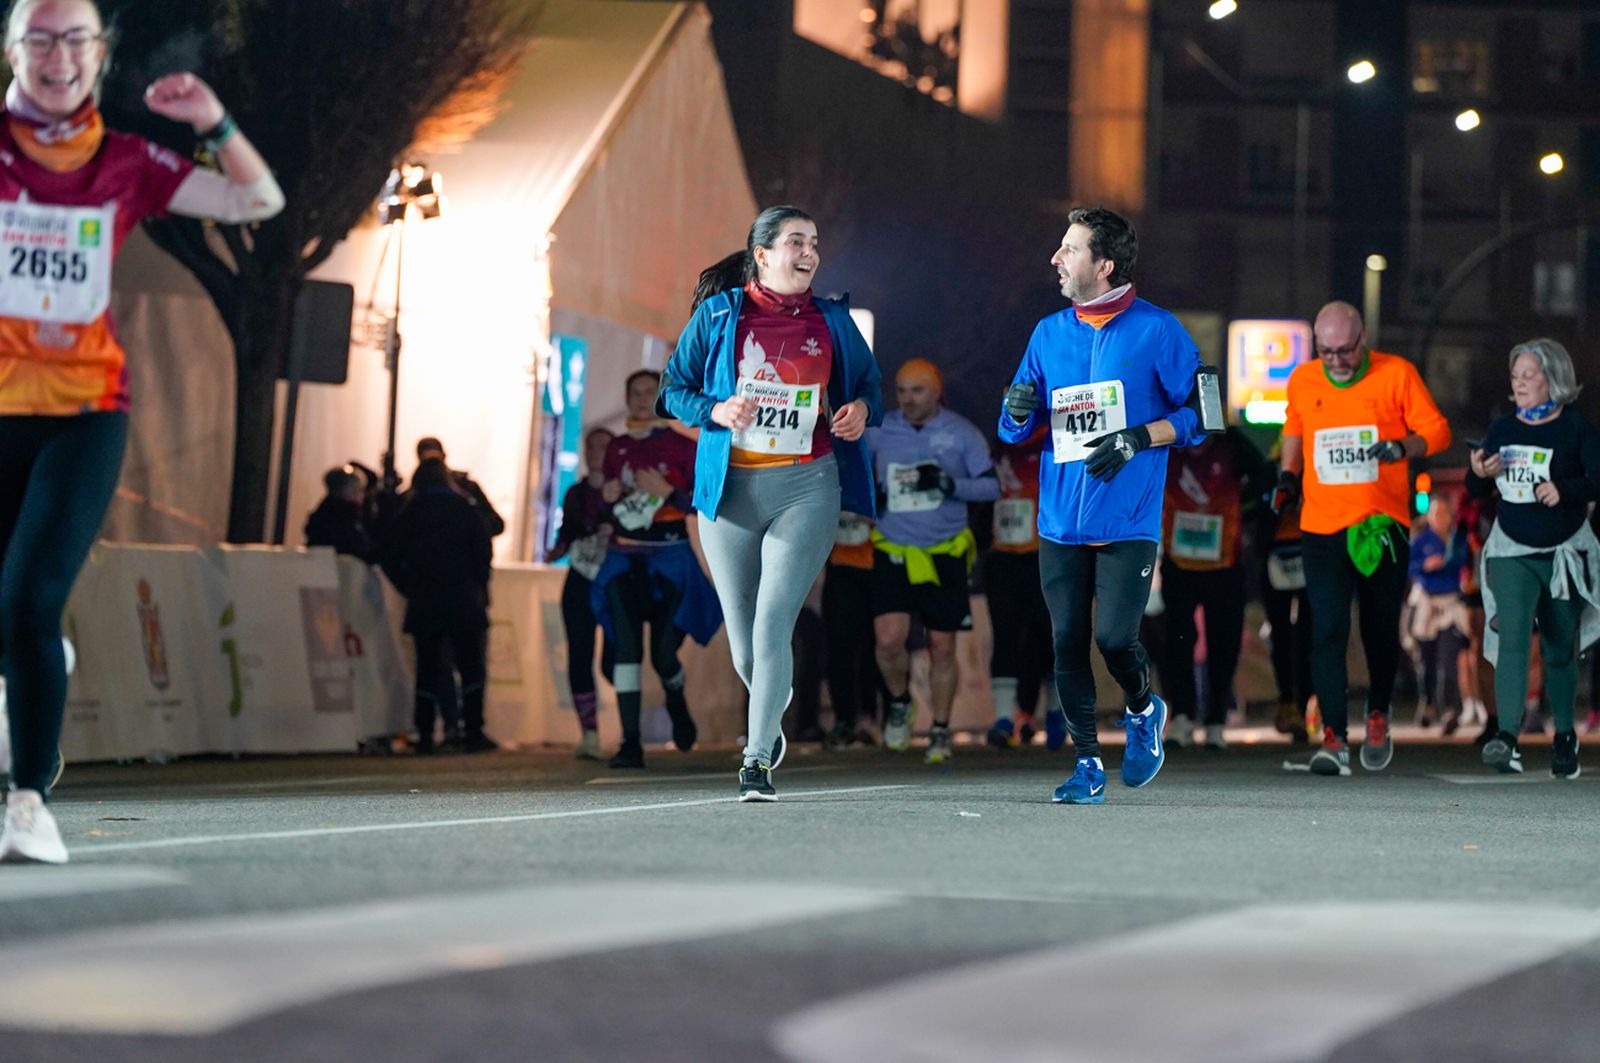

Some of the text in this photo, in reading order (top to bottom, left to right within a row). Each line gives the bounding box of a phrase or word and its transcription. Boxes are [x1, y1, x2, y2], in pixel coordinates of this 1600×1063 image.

[10, 246, 87, 283] 2655
[1085, 392, 1094, 400] DE
[1066, 409, 1107, 435] 4121
[1328, 447, 1366, 464] 1354
[1505, 465, 1535, 484] 1125
